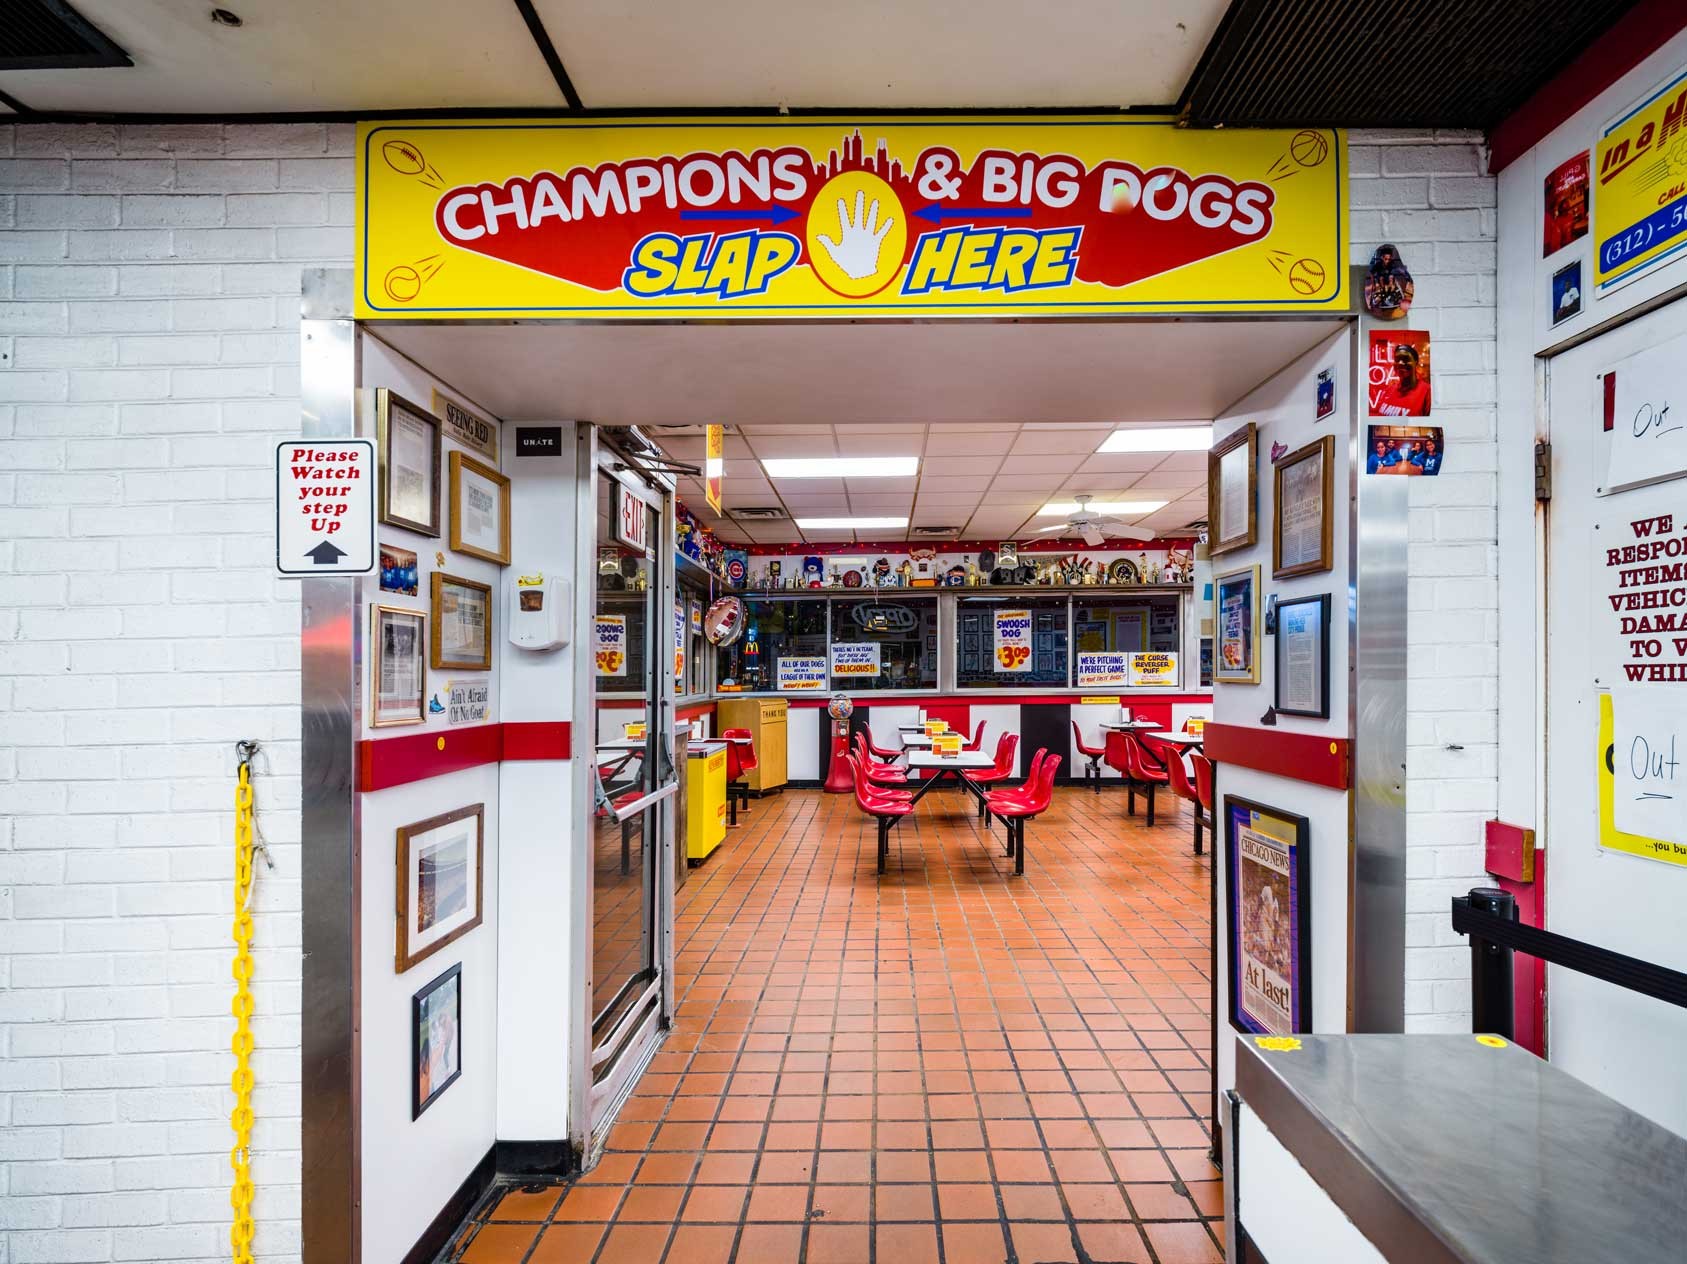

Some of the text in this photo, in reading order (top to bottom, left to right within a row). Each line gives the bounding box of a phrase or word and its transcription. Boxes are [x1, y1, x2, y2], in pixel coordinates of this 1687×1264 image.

[1600, 90, 1687, 176] In a H
[442, 152, 1269, 241] CHAMPIONS & BIG DOGS
[1657, 181, 1686, 206] CALL
[622, 224, 1086, 300] SLAP HERE
[446, 402, 474, 435] SEEING
[474, 420, 489, 444] RED
[1632, 400, 1670, 438] Out
[291, 449, 358, 462] Please
[291, 466, 360, 479] Watch
[299, 486, 351, 500] your
[302, 502, 348, 517] step
[625, 491, 643, 545] EXIT
[311, 518, 341, 534] Up
[1630, 514, 1673, 539] WE
[1606, 537, 1687, 567] RESPO
[1619, 562, 1687, 588] ITEM
[1608, 587, 1687, 611] VEHIC
[996, 619, 1030, 629] SWOOSH
[1001, 628, 1021, 638] DOG
[1630, 639, 1662, 658] TO
[792, 660, 799, 668] OF
[810, 660, 825, 668] DOGS
[1079, 664, 1125, 674] A PERFECT GAME
[1096, 655, 1123, 664] PITCHING
[780, 673, 799, 681] LEAGUE
[815, 673, 826, 681] OWN
[467, 687, 488, 704] Afraid
[450, 706, 459, 722] Of
[460, 705, 470, 721] No
[762, 709, 777, 719] THANK
[1630, 734, 1680, 780] Out
[1241, 838, 1270, 862] CHICAGO
[1270, 850, 1289, 871] NEWS
[1245, 960, 1260, 988] At
[1261, 980, 1290, 1012] last!
